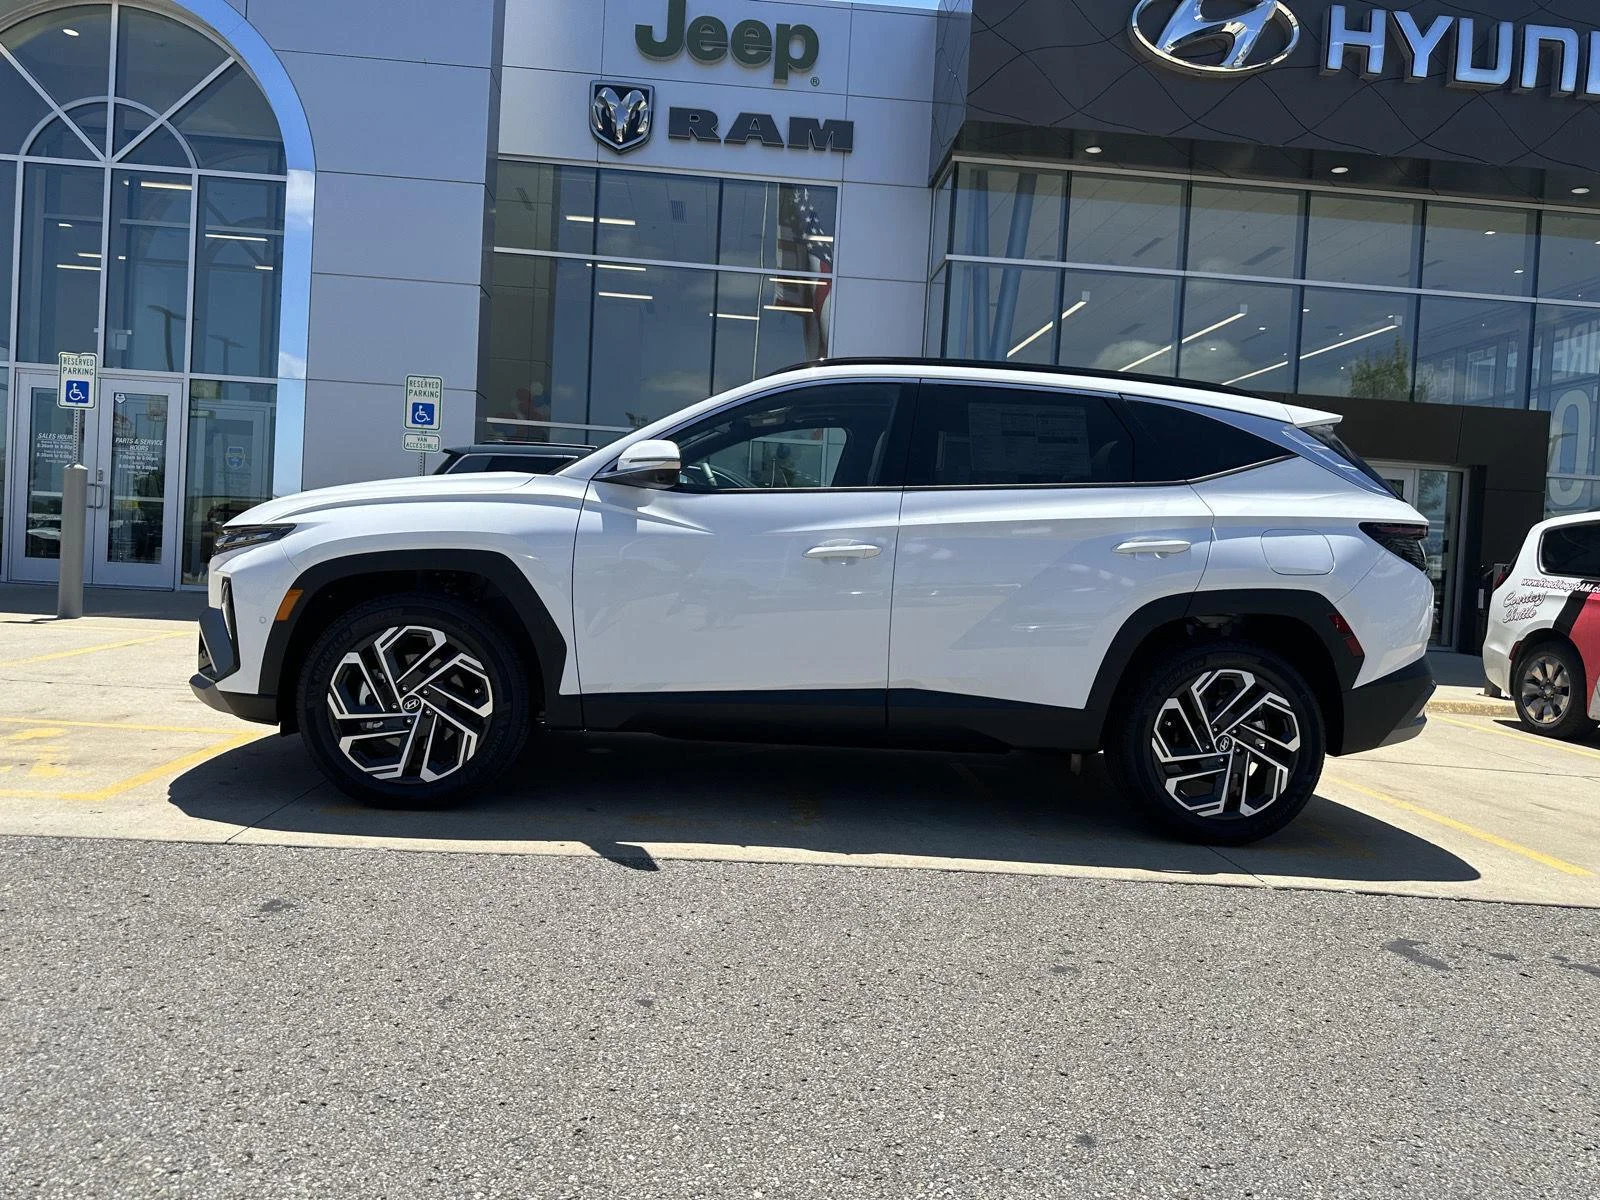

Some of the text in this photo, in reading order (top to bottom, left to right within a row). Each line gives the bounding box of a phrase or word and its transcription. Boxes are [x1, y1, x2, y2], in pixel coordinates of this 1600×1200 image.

[635, 0, 819, 84] Jeep
[1321, 4, 1600, 98] HYUN
[668, 106, 855, 153] RAM
[63, 357, 95, 367] RESERVED
[62, 366, 95, 376] PARKING
[409, 380, 440, 389] RESERVED
[408, 389, 439, 399] PARKING
[37, 432, 57, 440] SALES
[405, 442, 438, 450] ACCESSIBLE
[1503, 591, 1547, 608] Courtesy
[1502, 606, 1537, 623] Shuttle
